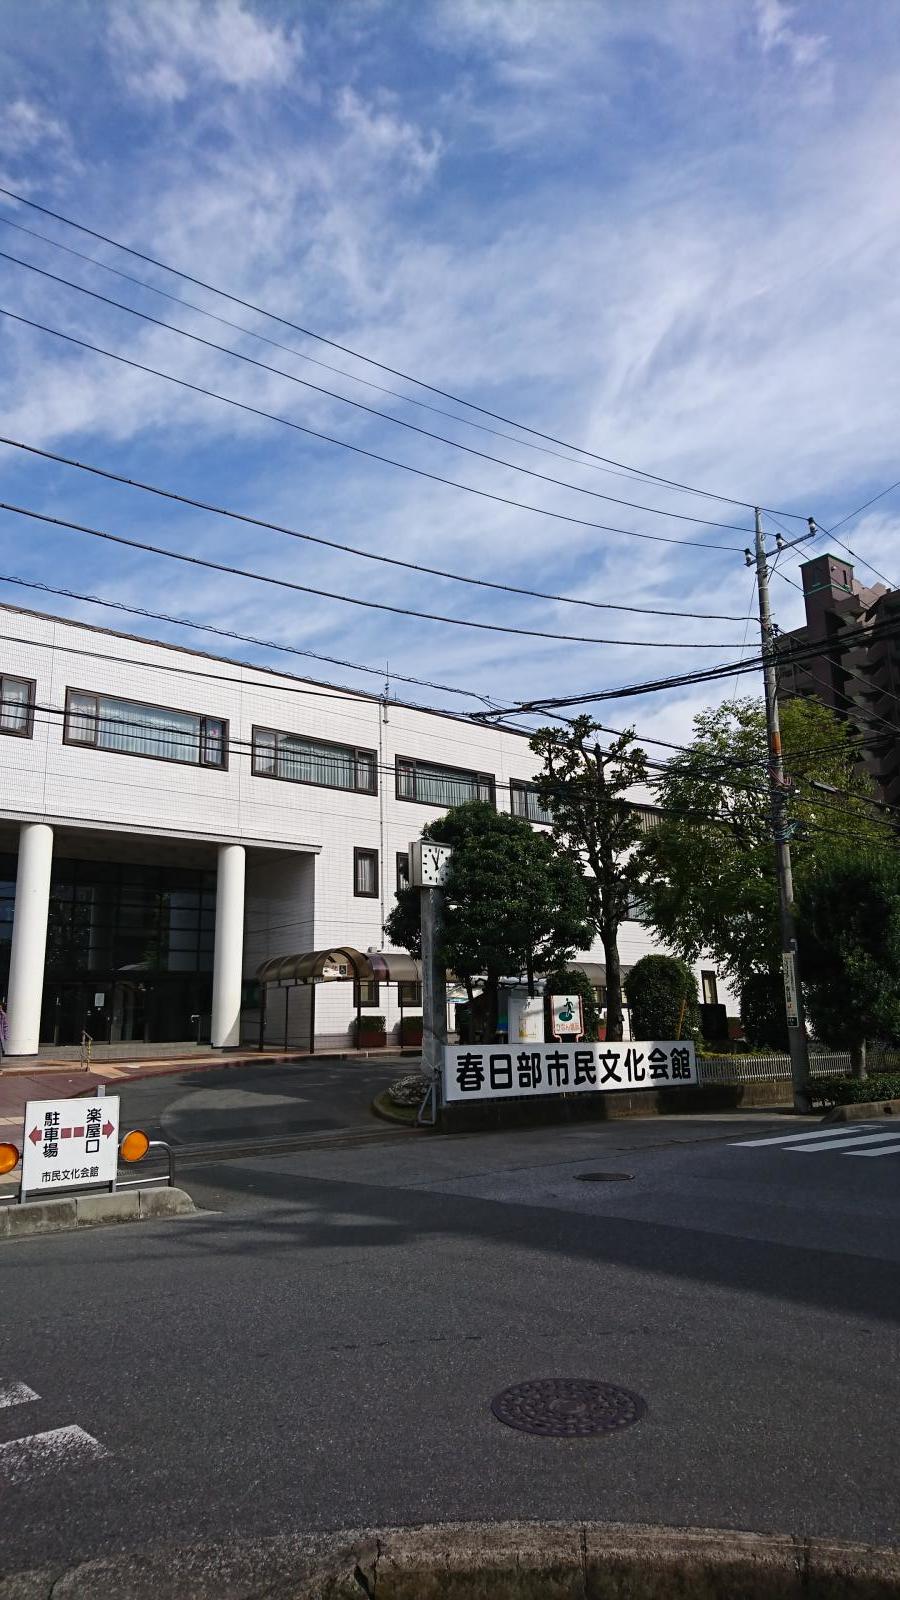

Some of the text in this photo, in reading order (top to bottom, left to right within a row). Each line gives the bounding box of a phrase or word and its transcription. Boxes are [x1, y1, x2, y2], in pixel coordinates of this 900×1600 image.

[456, 1047, 691, 1092] 春日部市民文化会館
[43, 1112, 60, 1158] 駐車場
[85, 1108, 102, 1153] 楽屋口
[42, 1166, 99, 1182] 市民文化会館
